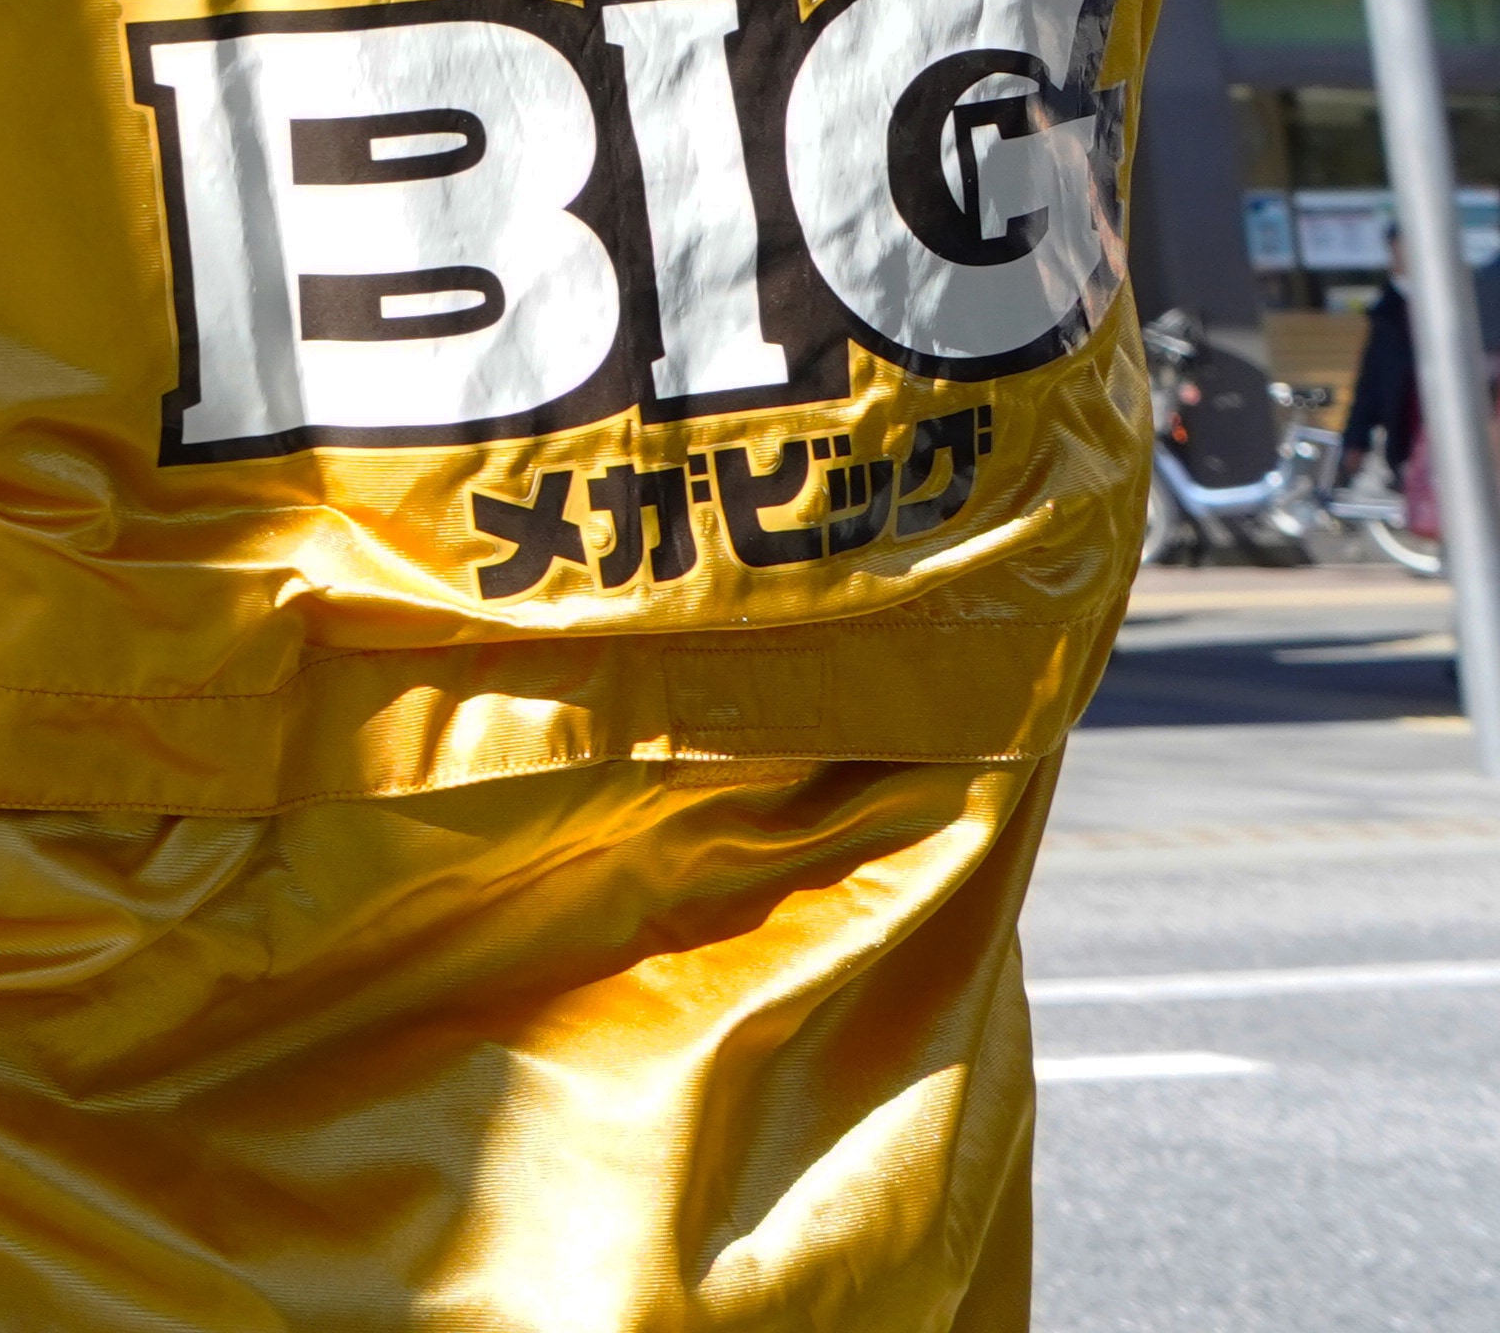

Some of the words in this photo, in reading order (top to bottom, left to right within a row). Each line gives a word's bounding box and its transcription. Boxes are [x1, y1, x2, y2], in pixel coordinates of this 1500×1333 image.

[471, 405, 993, 600] メガビッグ
